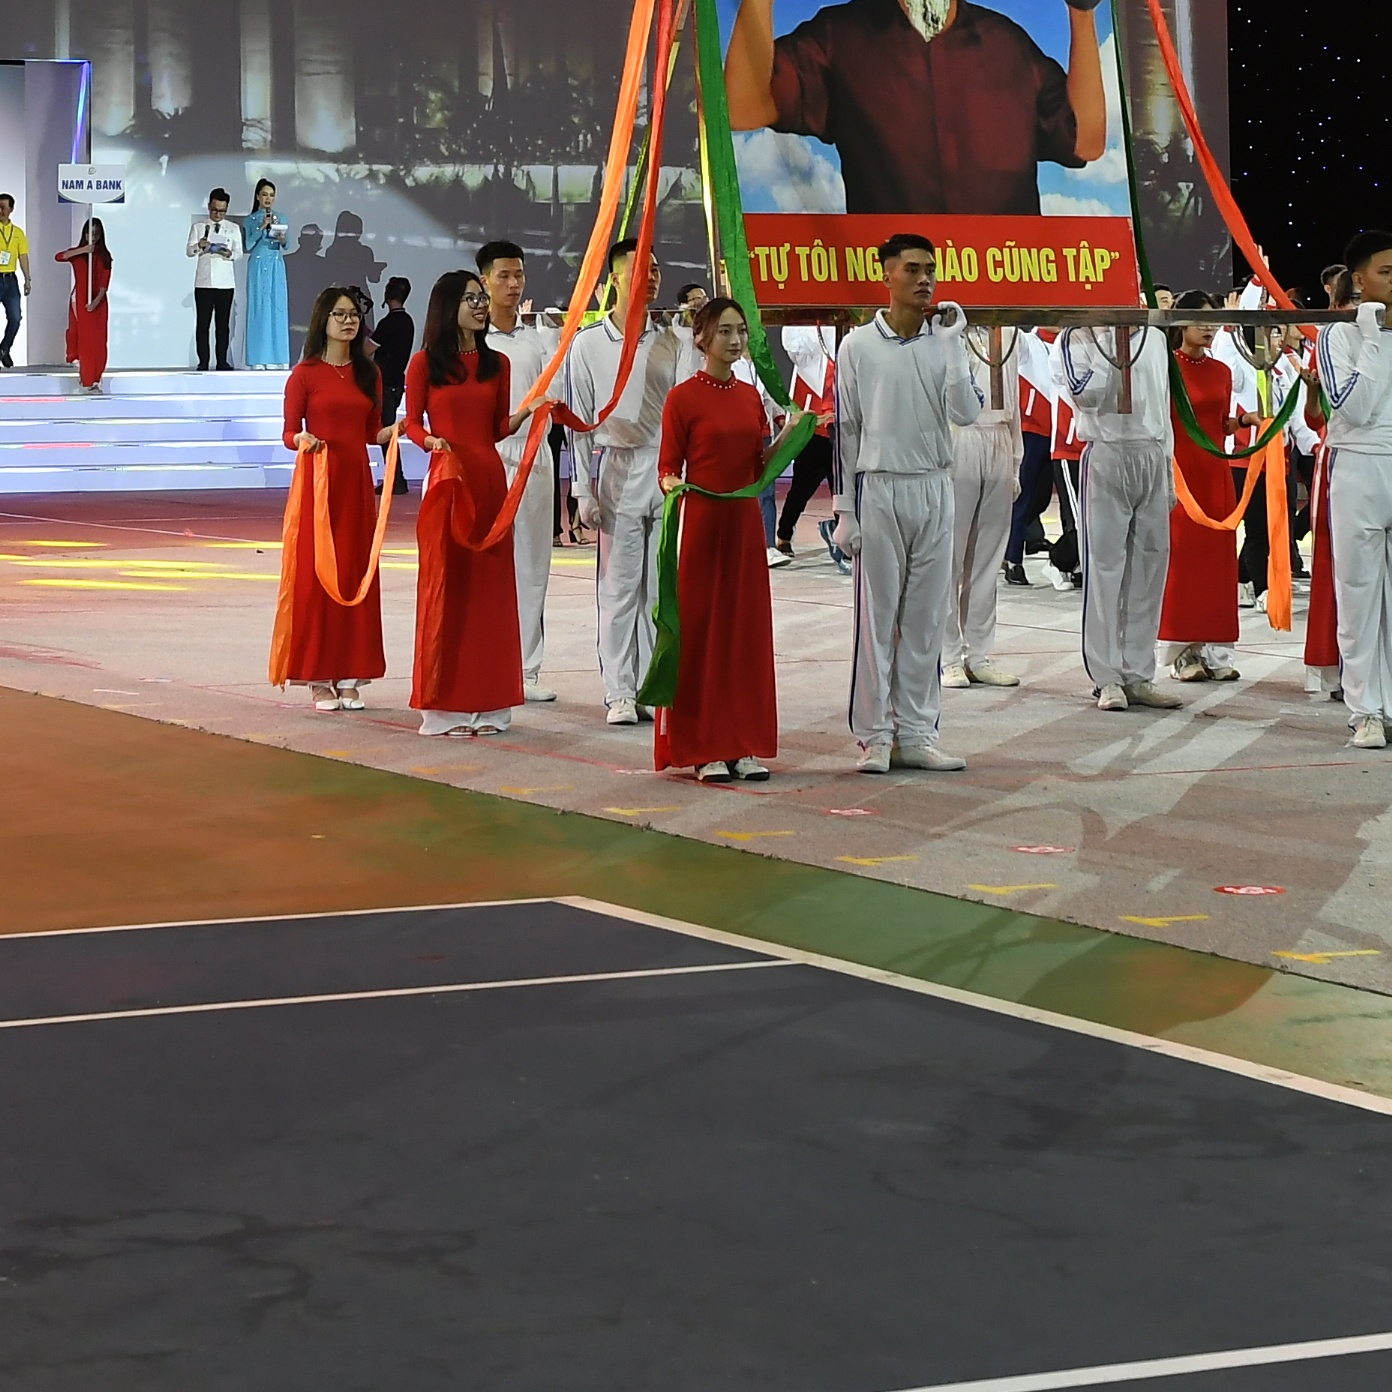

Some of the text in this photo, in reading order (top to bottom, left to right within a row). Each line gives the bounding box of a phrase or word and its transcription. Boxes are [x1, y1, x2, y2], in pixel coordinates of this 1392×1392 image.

[61, 180, 122, 190] NAM A BANK
[795, 239, 838, 282] TÔI
[985, 240, 1058, 283] CŨNG
